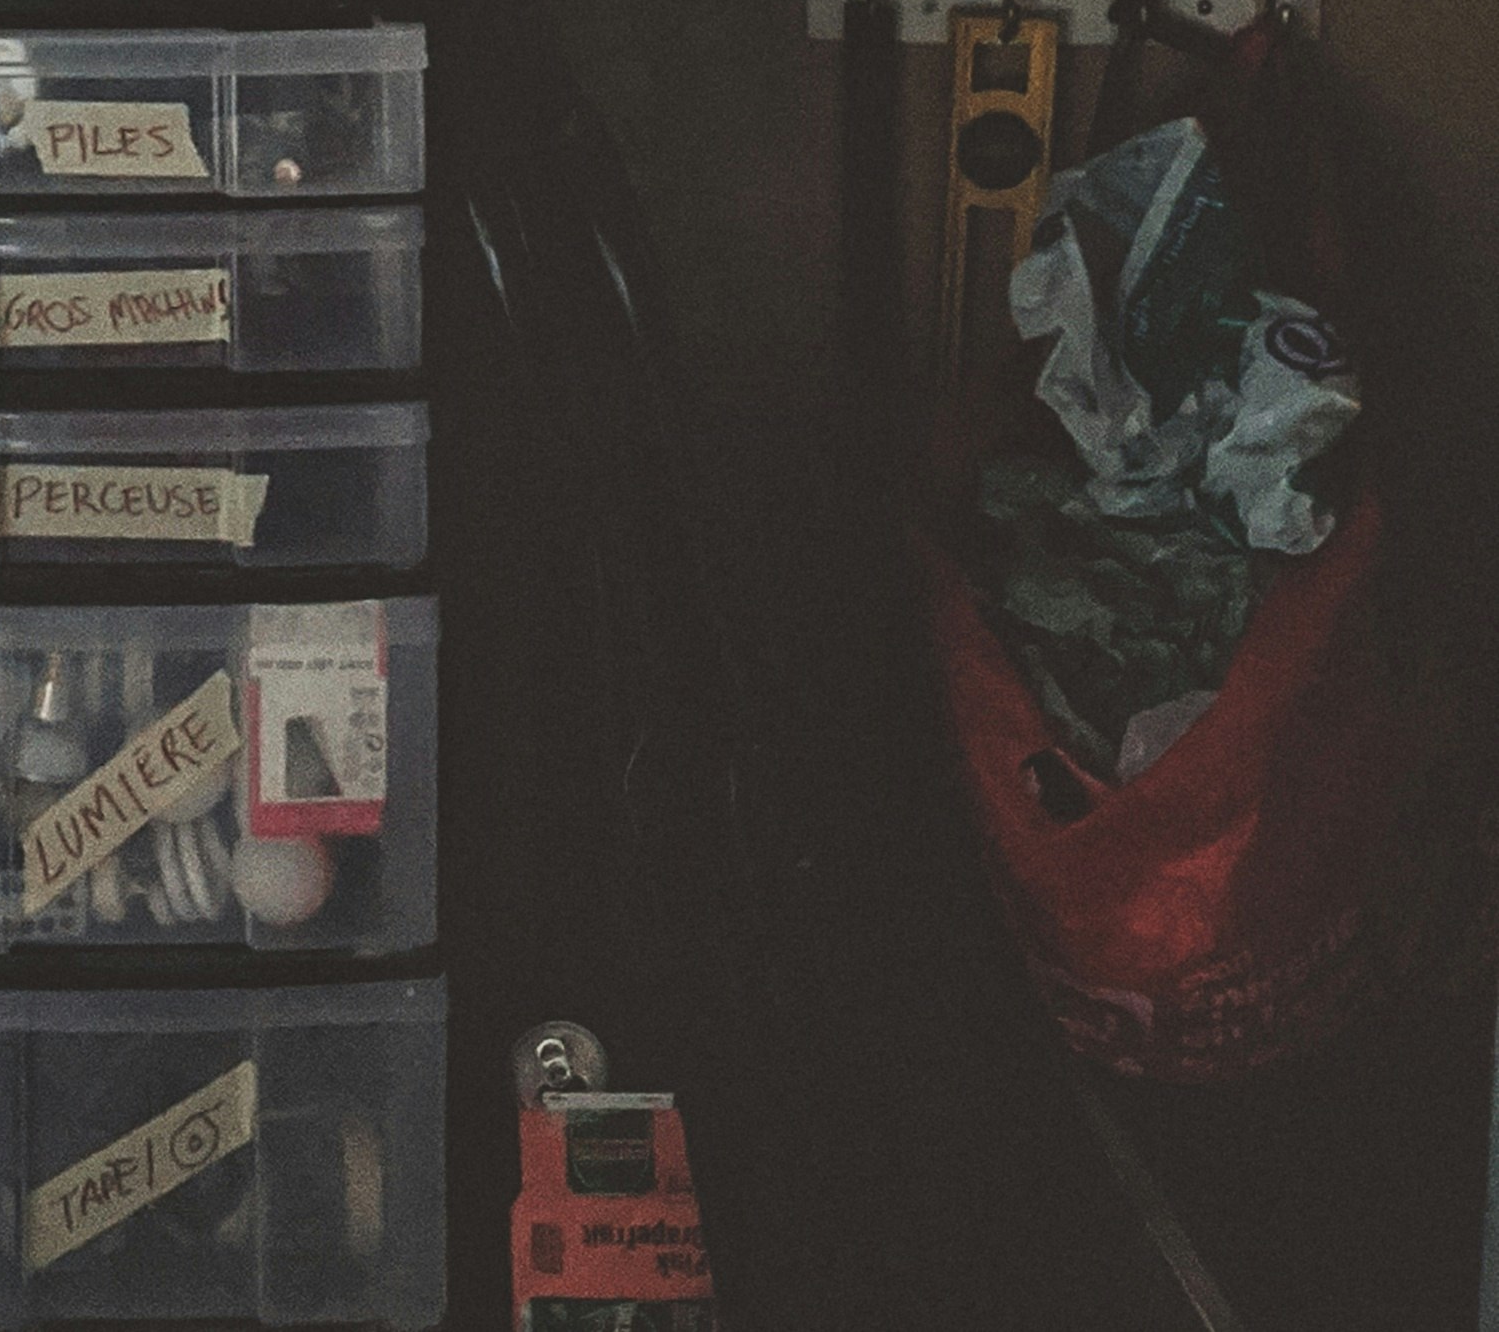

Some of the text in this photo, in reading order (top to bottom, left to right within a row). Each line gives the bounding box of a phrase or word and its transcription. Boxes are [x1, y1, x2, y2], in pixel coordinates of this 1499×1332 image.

[46, 122, 175, 164] PILES
[4, 291, 93, 333] GROS
[11, 474, 221, 520] PERCEUSE
